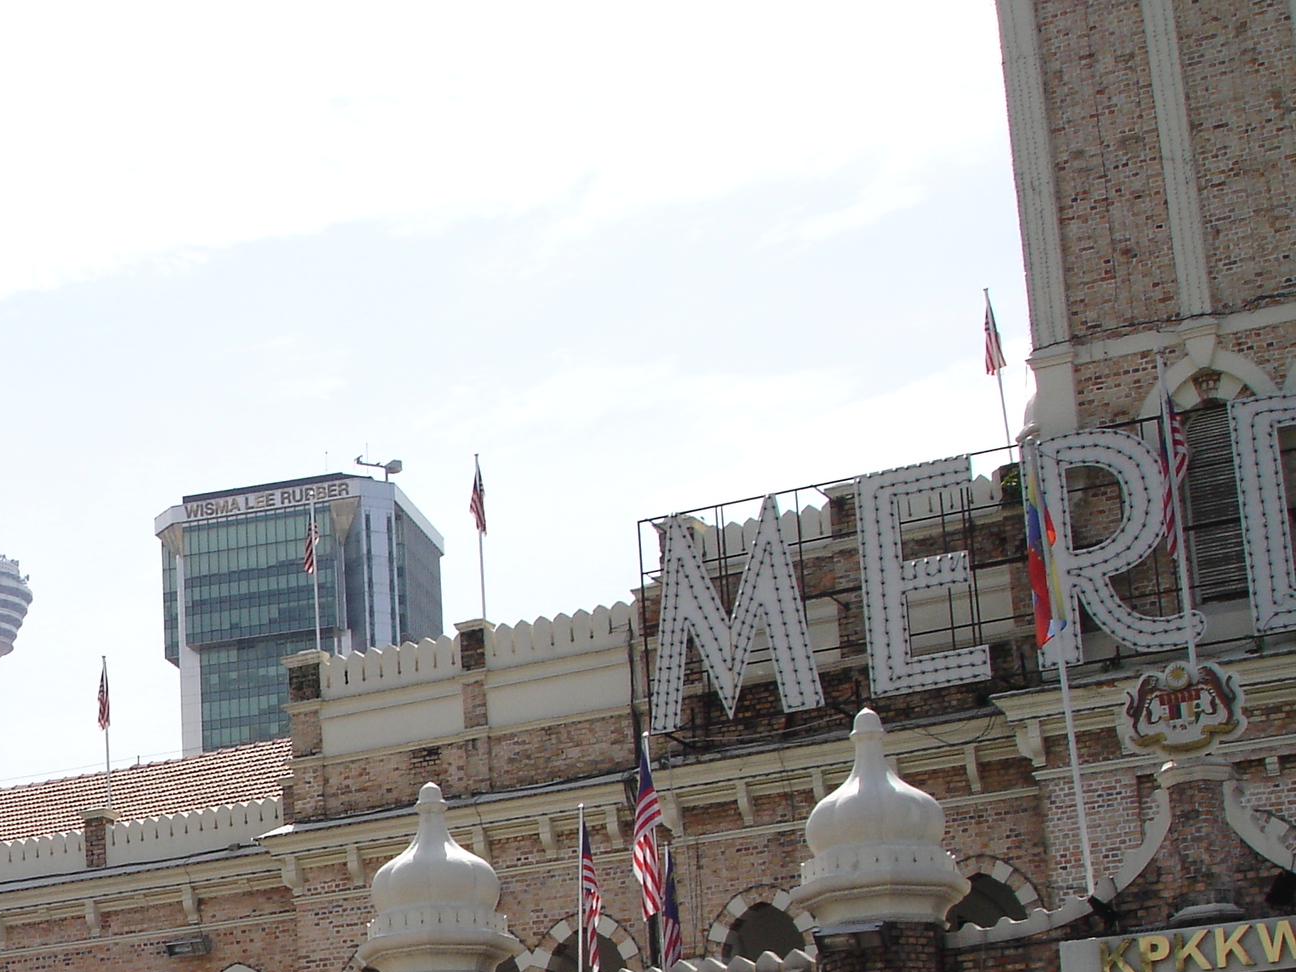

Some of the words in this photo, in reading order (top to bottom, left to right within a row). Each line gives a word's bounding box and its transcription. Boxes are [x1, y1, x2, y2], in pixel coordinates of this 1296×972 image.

[184, 498, 241, 519] WISMA
[245, 492, 276, 510] LEE
[280, 482, 350, 506] RUBBER
